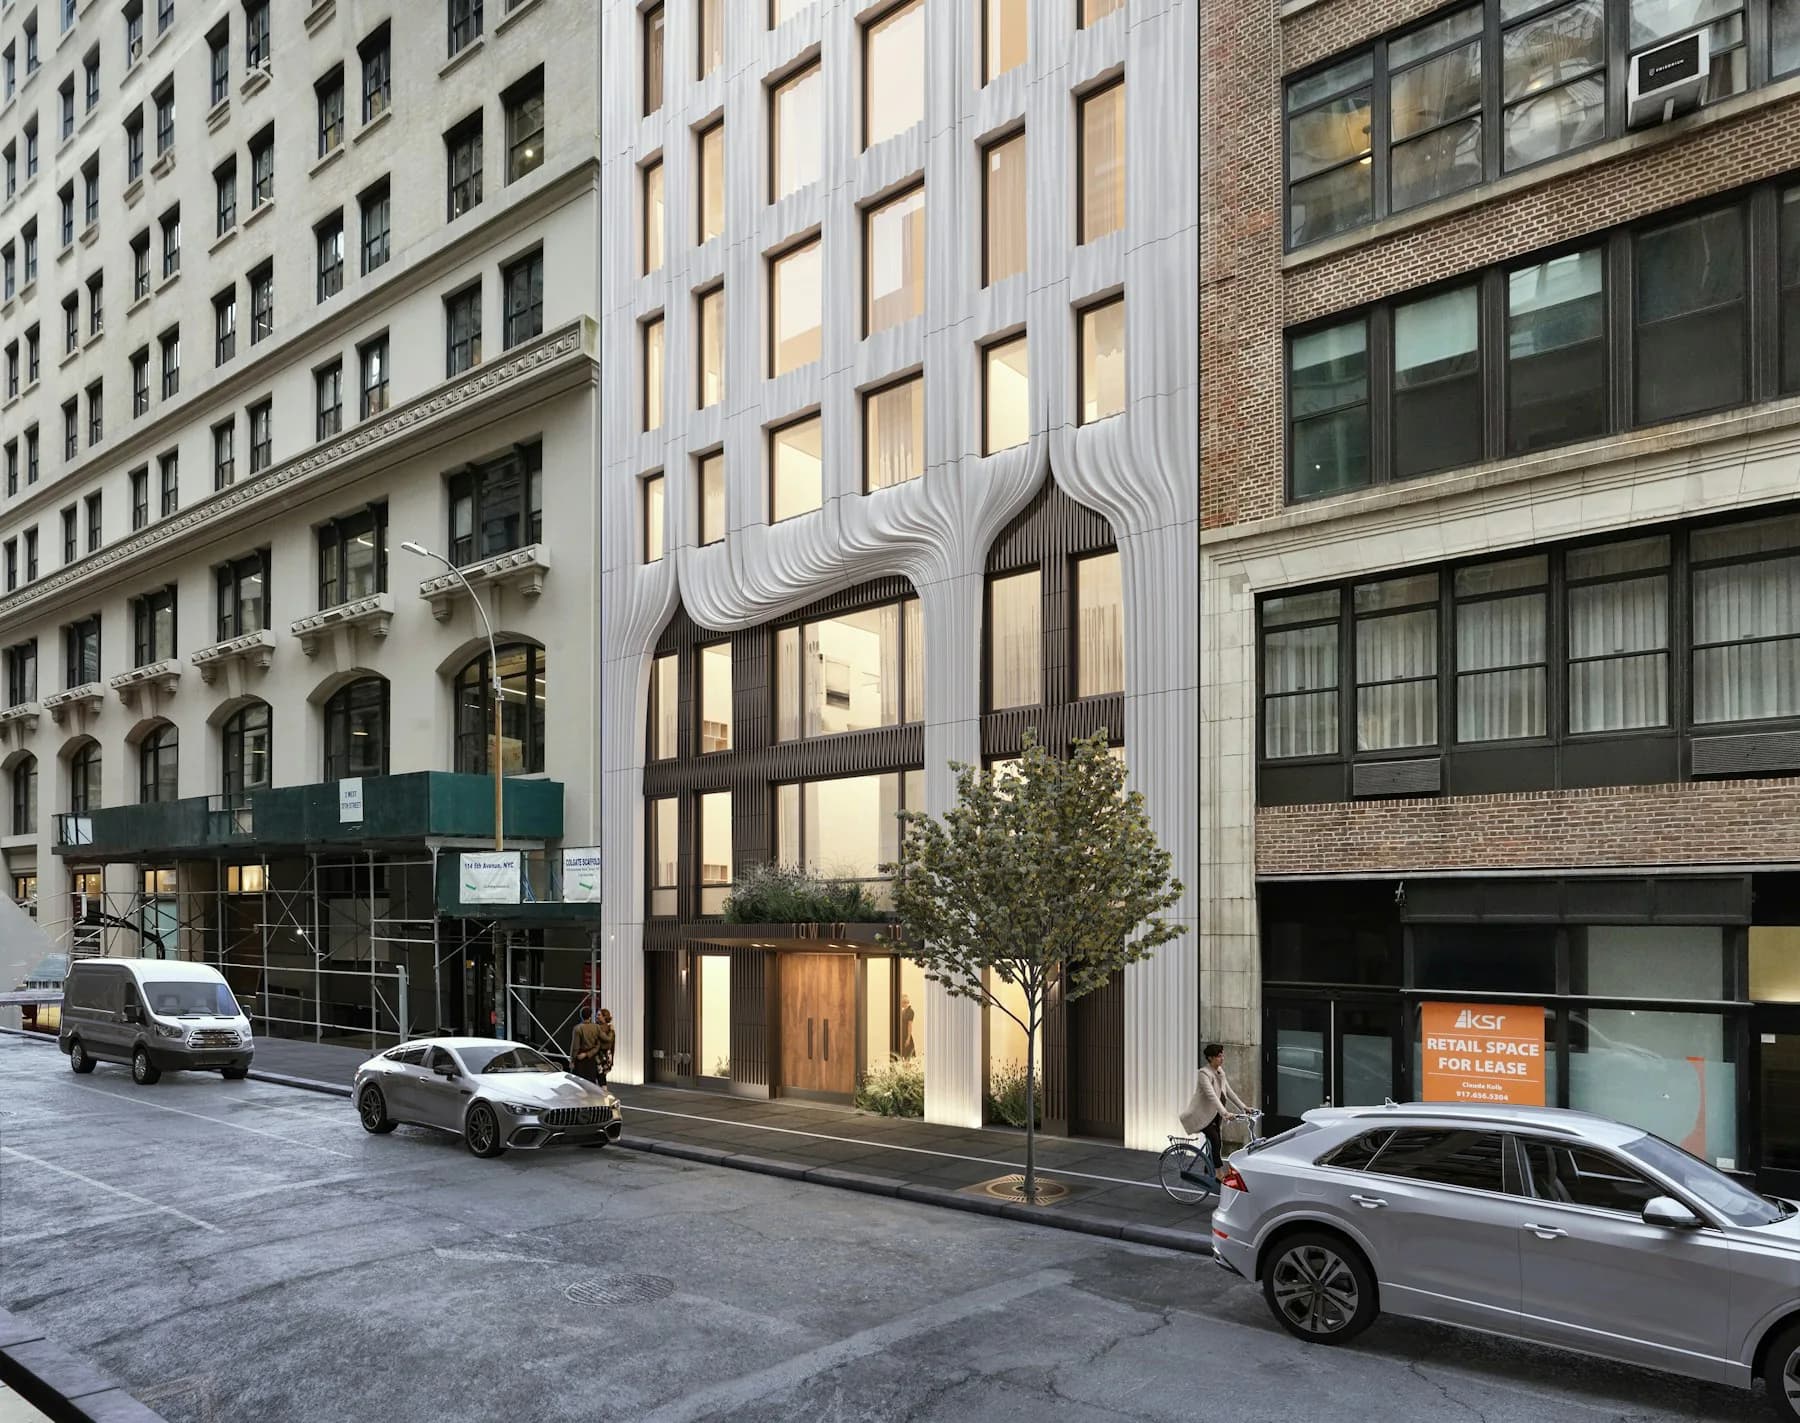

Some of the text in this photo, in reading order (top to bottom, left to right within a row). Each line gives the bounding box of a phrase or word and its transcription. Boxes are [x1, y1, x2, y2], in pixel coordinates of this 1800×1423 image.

[1466, 1009, 1506, 1030] ksr
[1427, 1037, 1539, 1057] RETAIL SPACE
[1438, 1057, 1527, 1076] FOR LEASE
